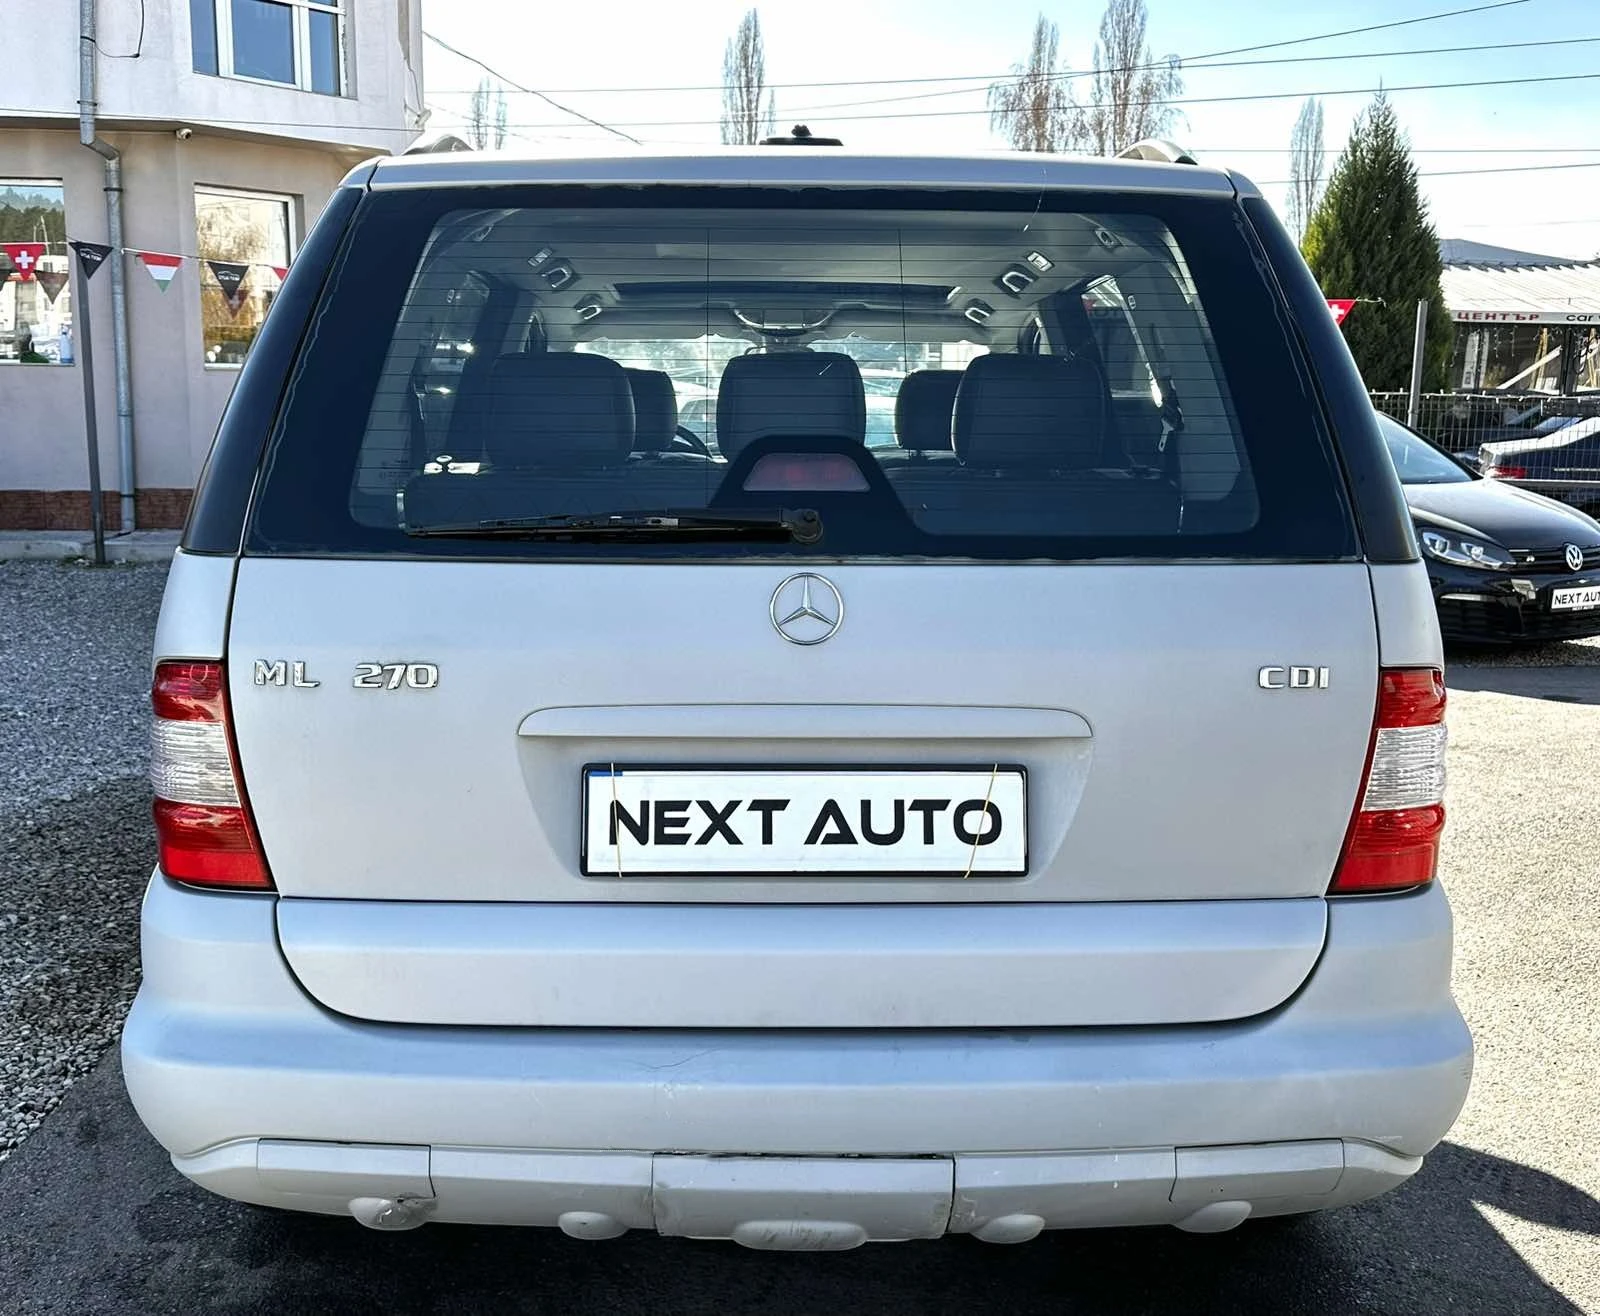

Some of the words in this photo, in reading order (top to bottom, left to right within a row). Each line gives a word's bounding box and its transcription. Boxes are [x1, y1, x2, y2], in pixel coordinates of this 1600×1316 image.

[1457, 311, 1540, 321] ЦЕНТЪР
[1566, 314, 1593, 322] car
[1554, 592, 1582, 605] NEXT
[254, 659, 321, 688] ML
[352, 662, 438, 690] 270
[1258, 665, 1329, 689] CDI
[608, 799, 791, 846] NEXT
[803, 798, 1003, 846] AUTO
